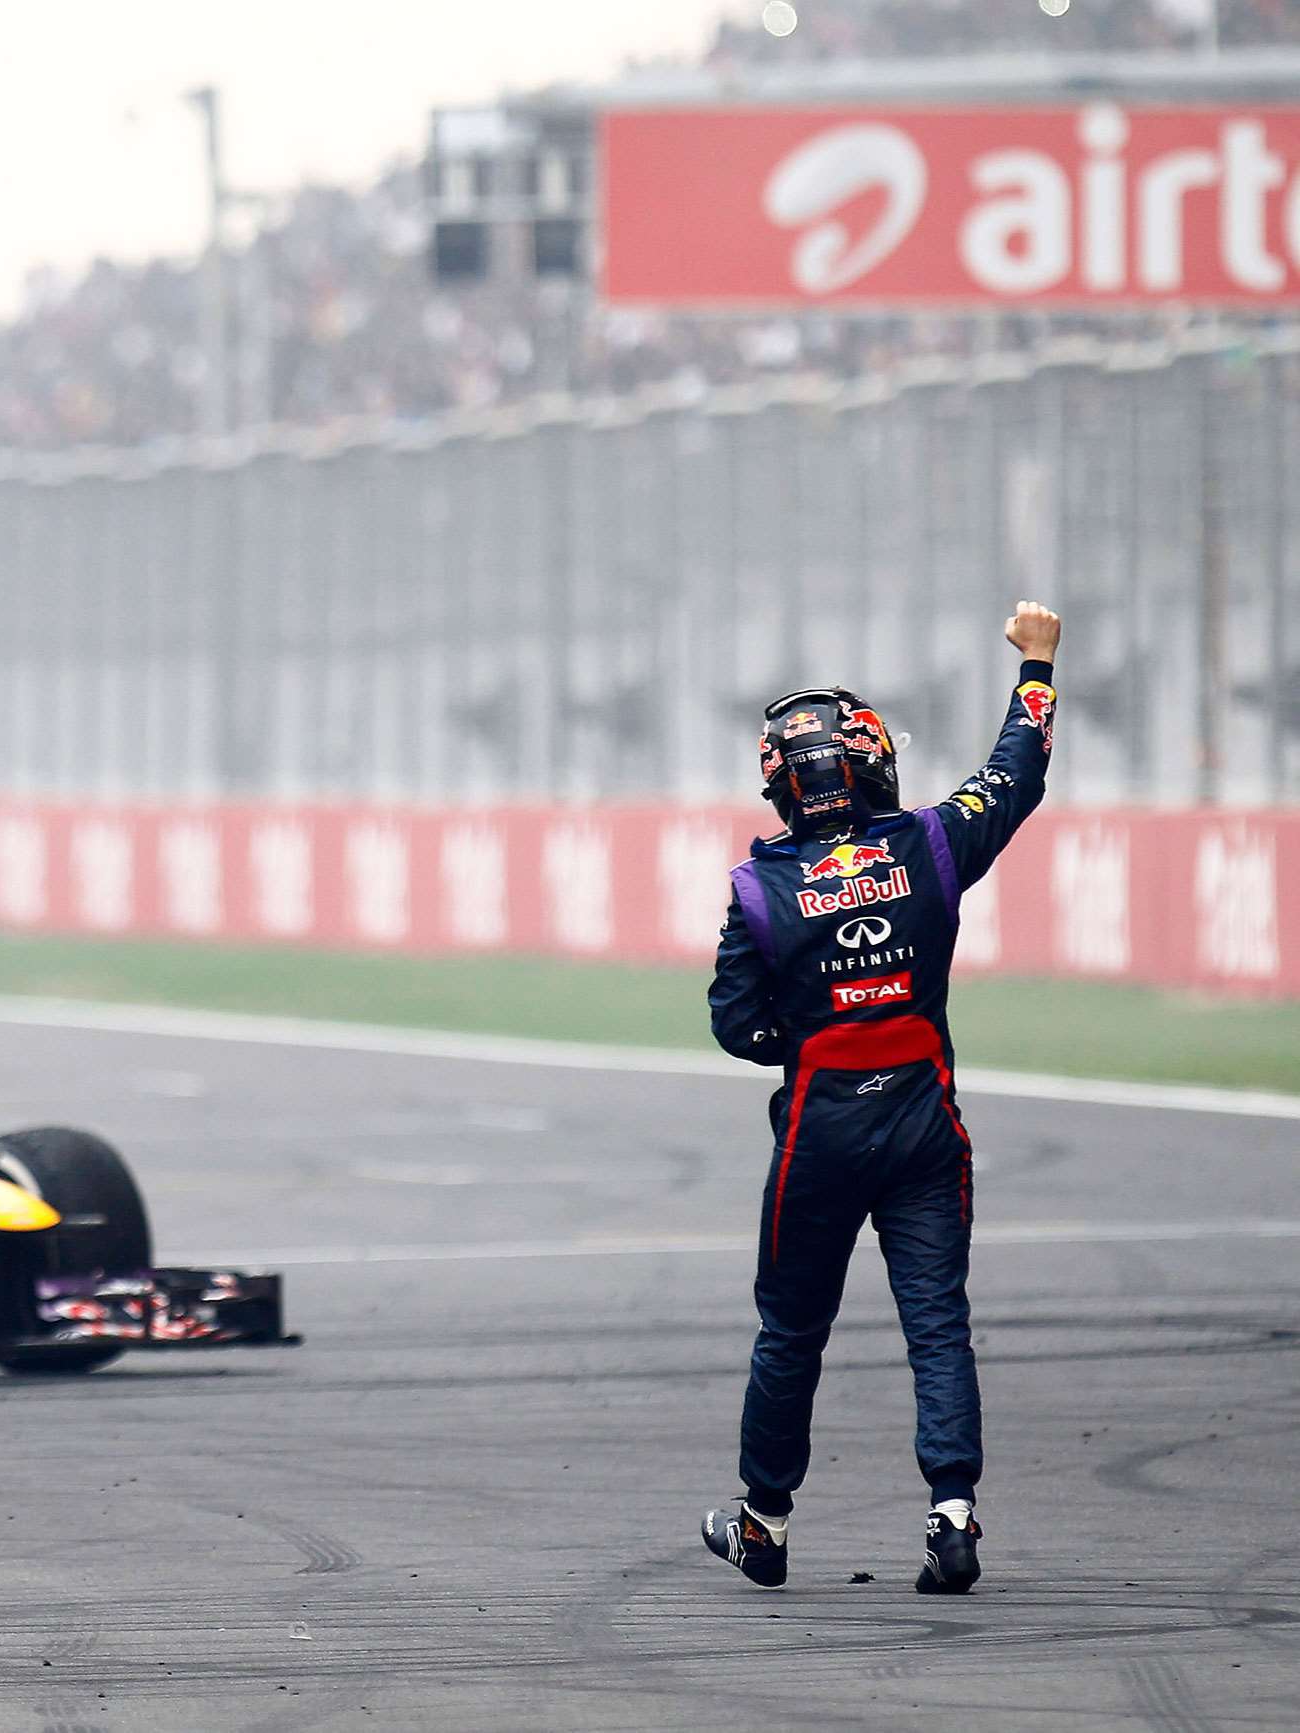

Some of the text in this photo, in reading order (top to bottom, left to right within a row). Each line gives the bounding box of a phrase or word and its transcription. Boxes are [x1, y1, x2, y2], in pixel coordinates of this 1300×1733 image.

[958, 102, 1300, 293] airt
[796, 866, 911, 918] Red Bull
[820, 946, 914, 972] INFINITI
[834, 982, 908, 1004] TOTAL
